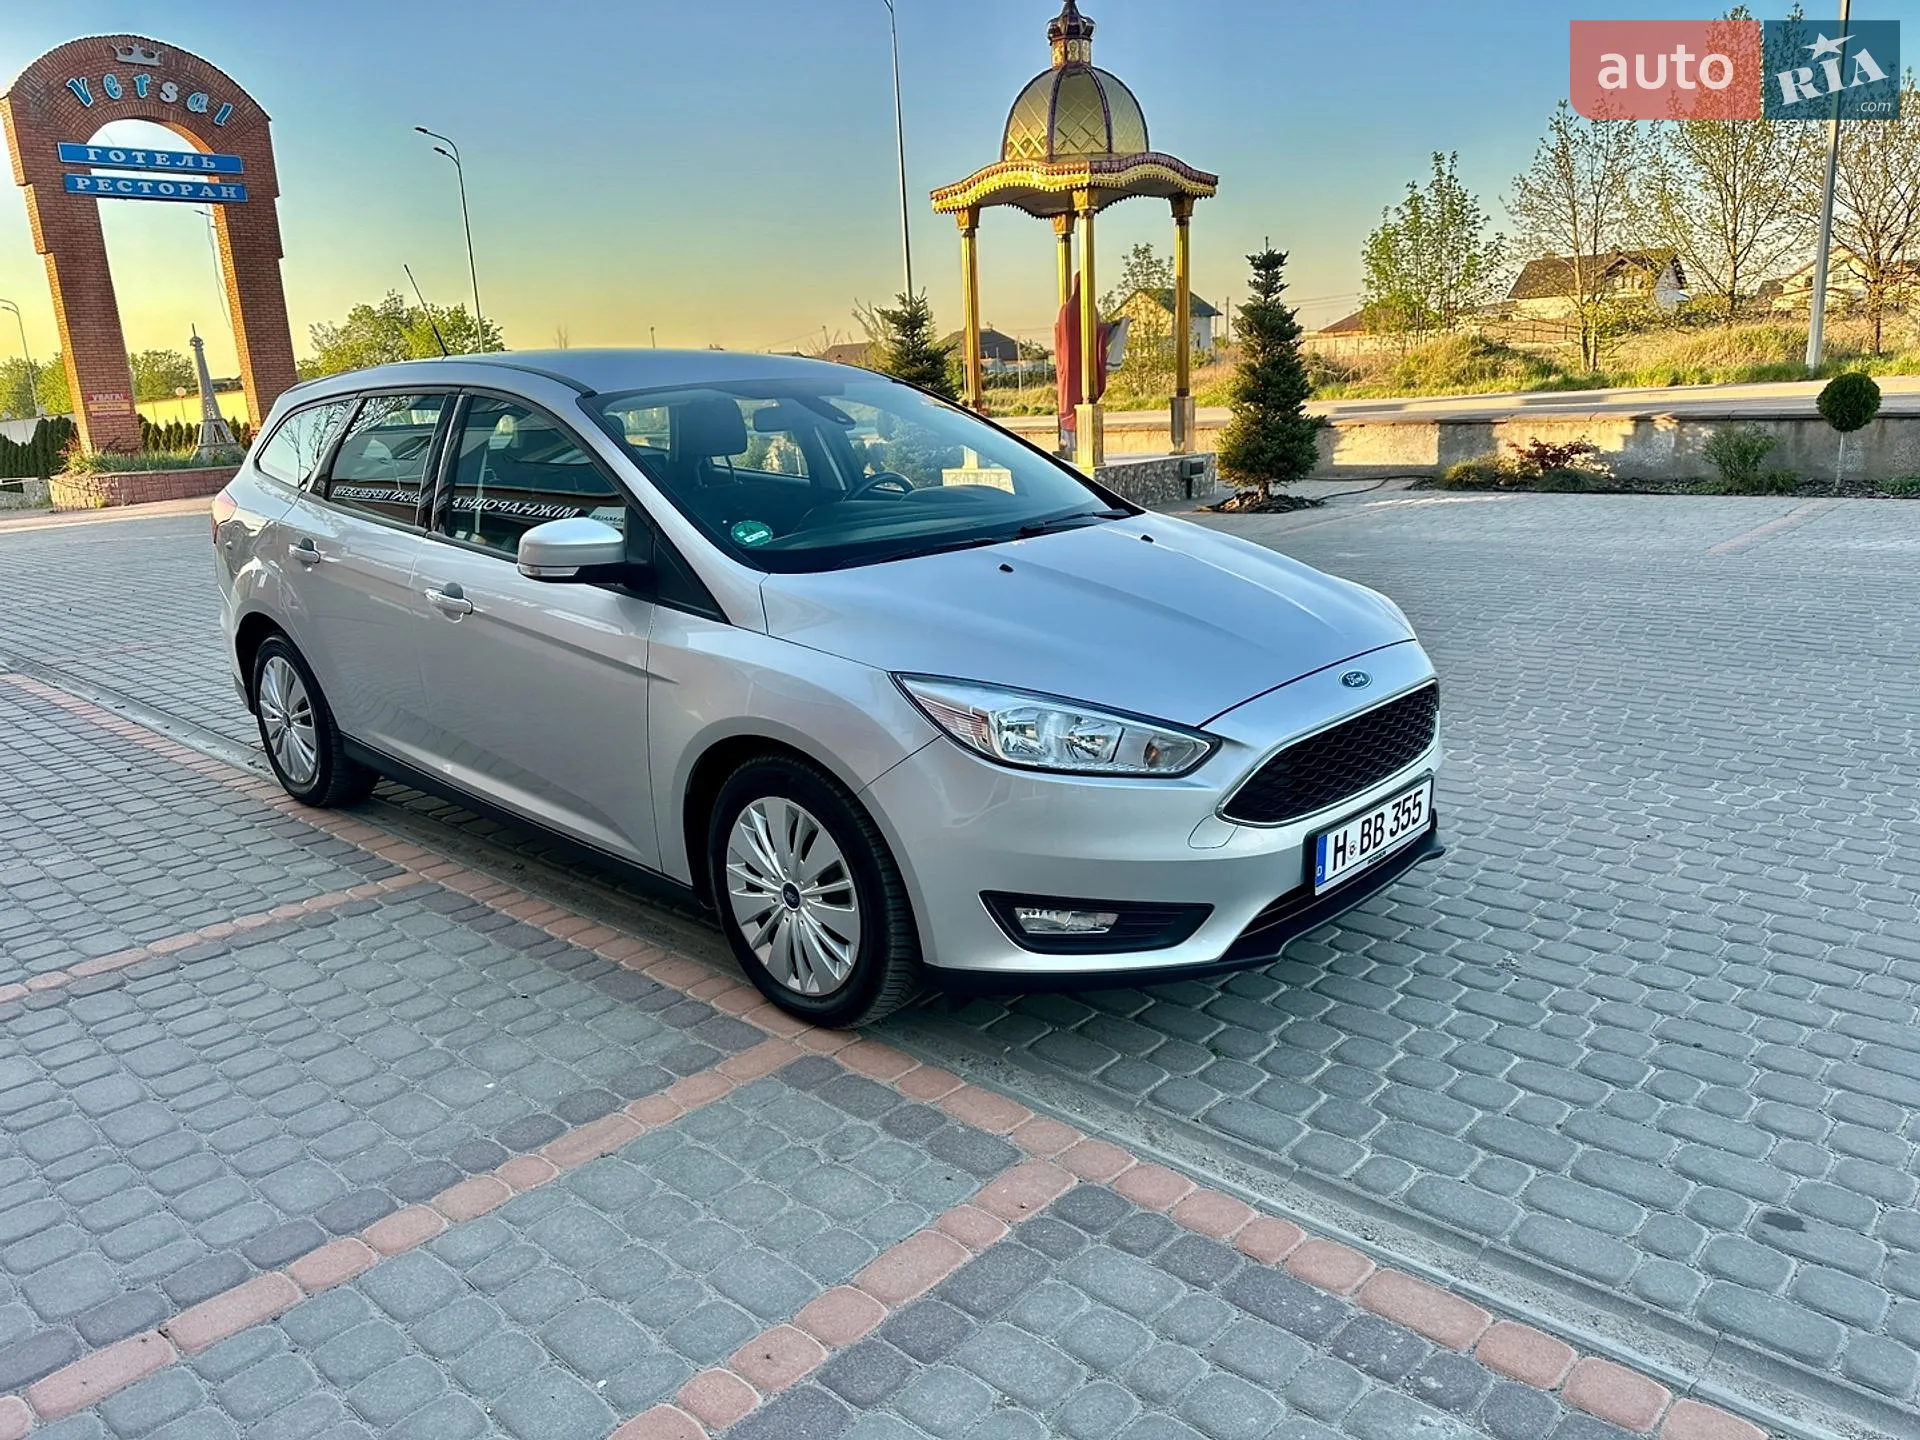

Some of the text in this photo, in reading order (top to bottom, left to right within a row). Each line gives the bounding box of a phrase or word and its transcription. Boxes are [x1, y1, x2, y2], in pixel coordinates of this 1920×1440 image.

[66, 73, 233, 126] Versal
[87, 147, 216, 169] ГОТЕЛЬ
[75, 176, 238, 199] РЕСТОРАН
[1333, 830, 1348, 871] H
[1360, 812, 1385, 855] BB
[1390, 789, 1424, 837] 355
